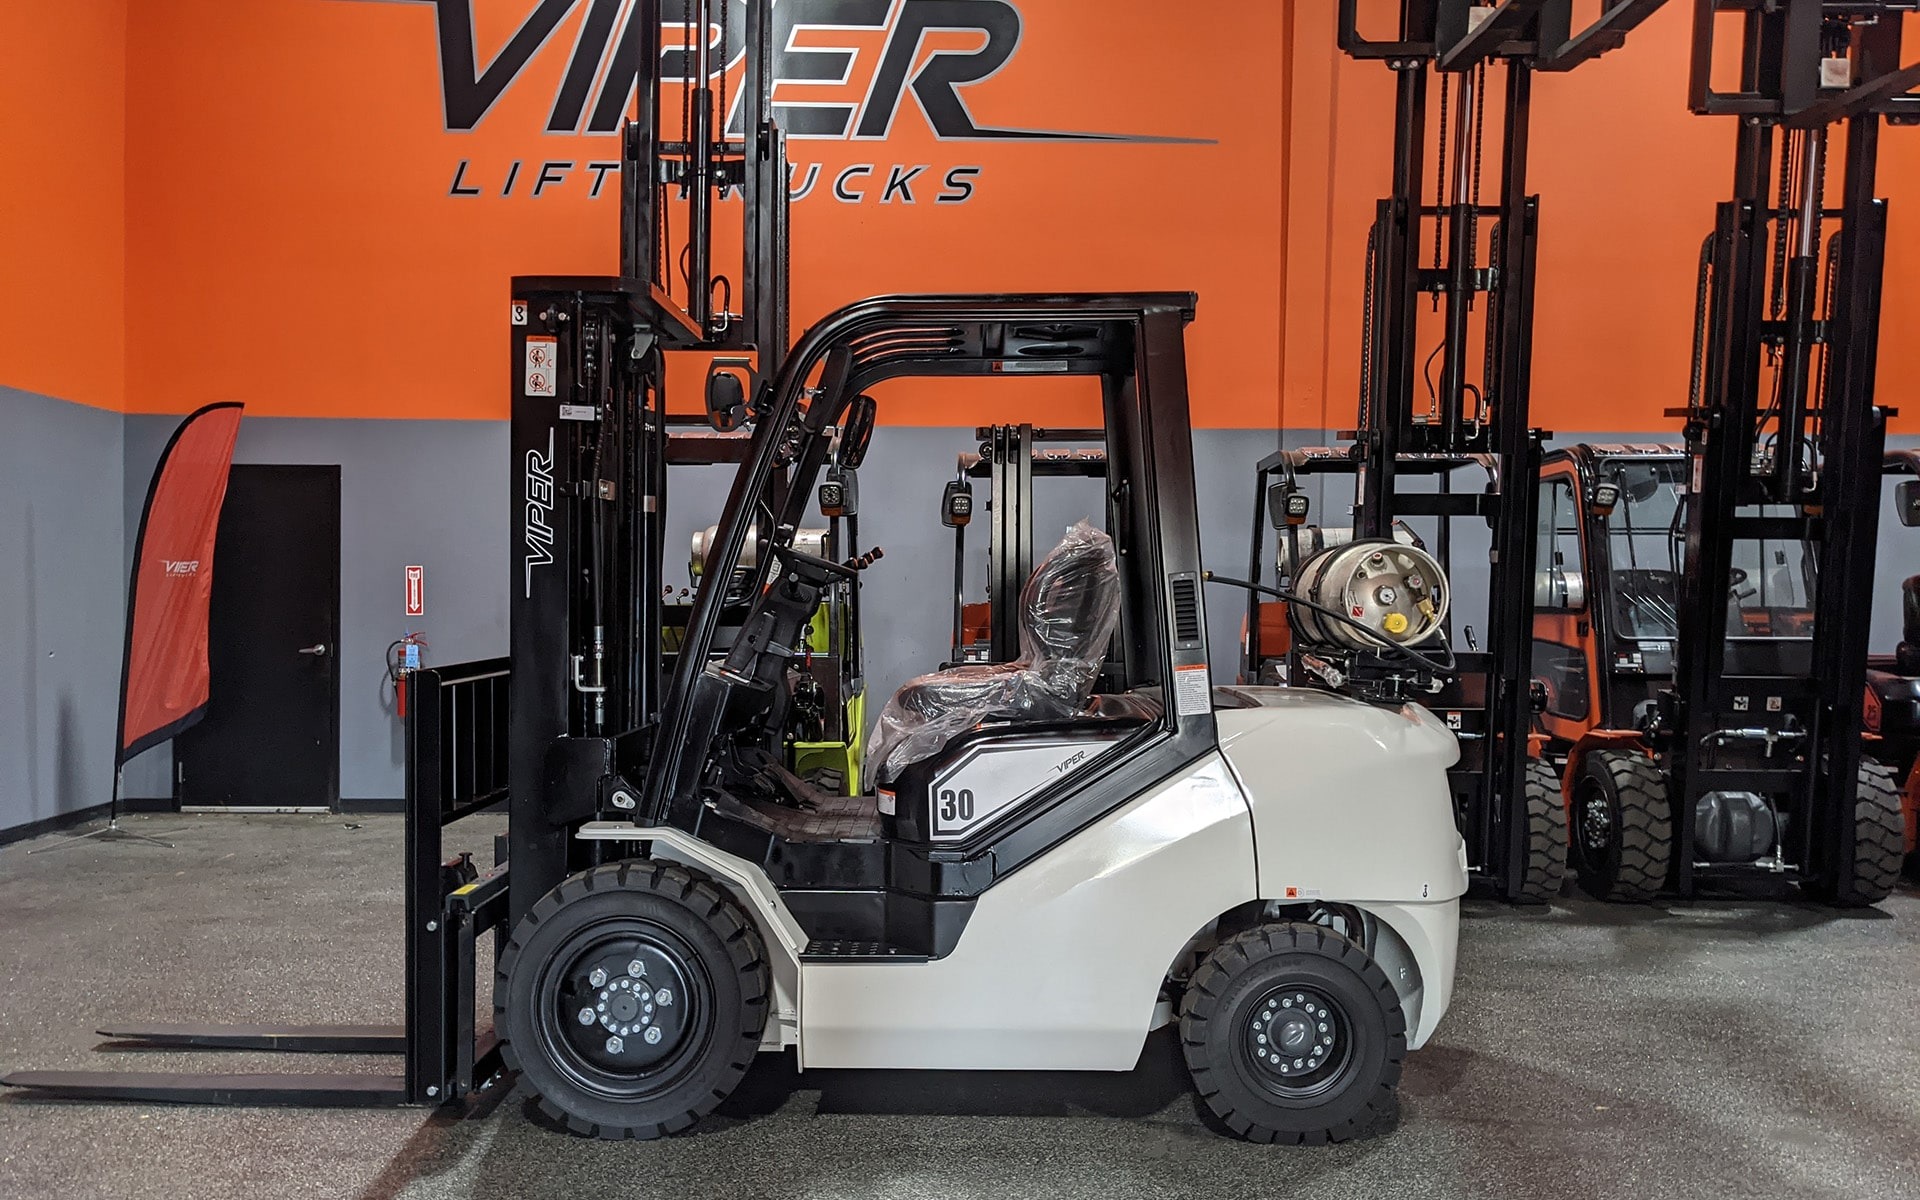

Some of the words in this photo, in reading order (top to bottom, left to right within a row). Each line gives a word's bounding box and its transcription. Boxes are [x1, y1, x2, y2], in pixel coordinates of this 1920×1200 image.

[433, 0, 1217, 142] VIPER
[449, 159, 623, 199] LIFT
[676, 162, 984, 205] UCKS
[526, 427, 554, 598] VIPER
[1050, 750, 1090, 773] VIPER
[940, 789, 974, 821] 30
